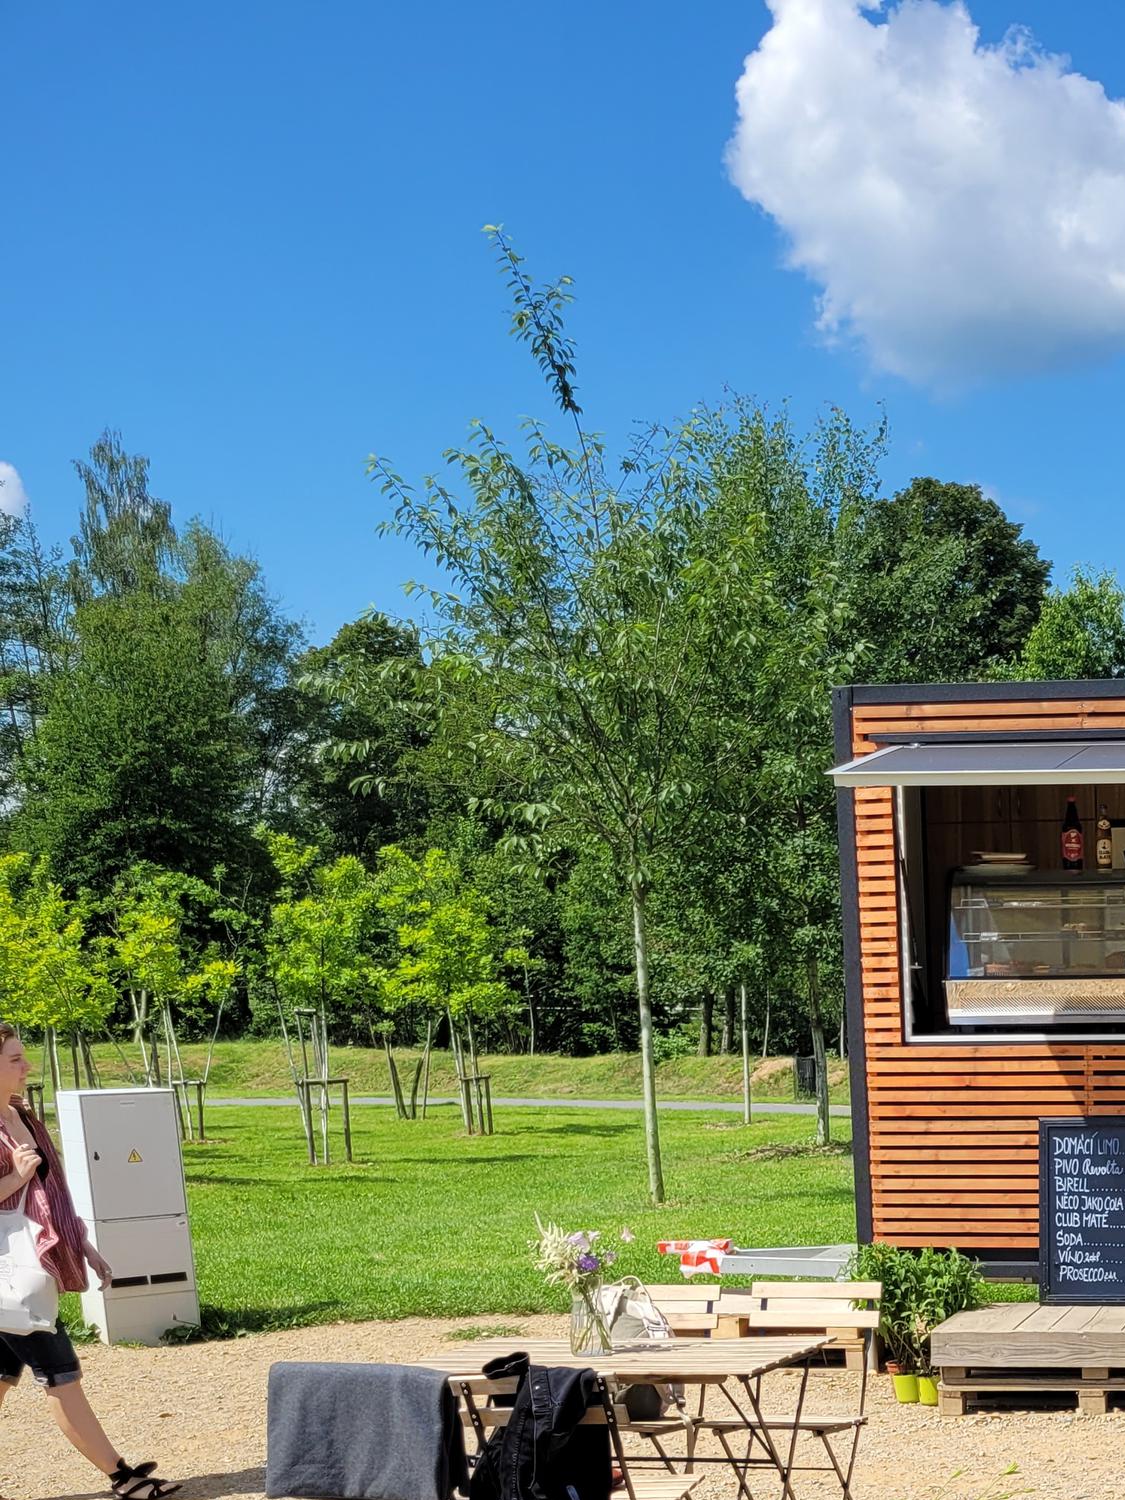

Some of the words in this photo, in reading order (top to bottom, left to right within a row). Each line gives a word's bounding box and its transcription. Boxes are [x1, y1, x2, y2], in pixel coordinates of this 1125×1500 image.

[1054, 1159, 1079, 1175] PIVO
[1082, 1158, 1124, 1175] Revolta
[1054, 1177, 1090, 1192] BIRELL
[1056, 1212, 1080, 1228] CLUB
